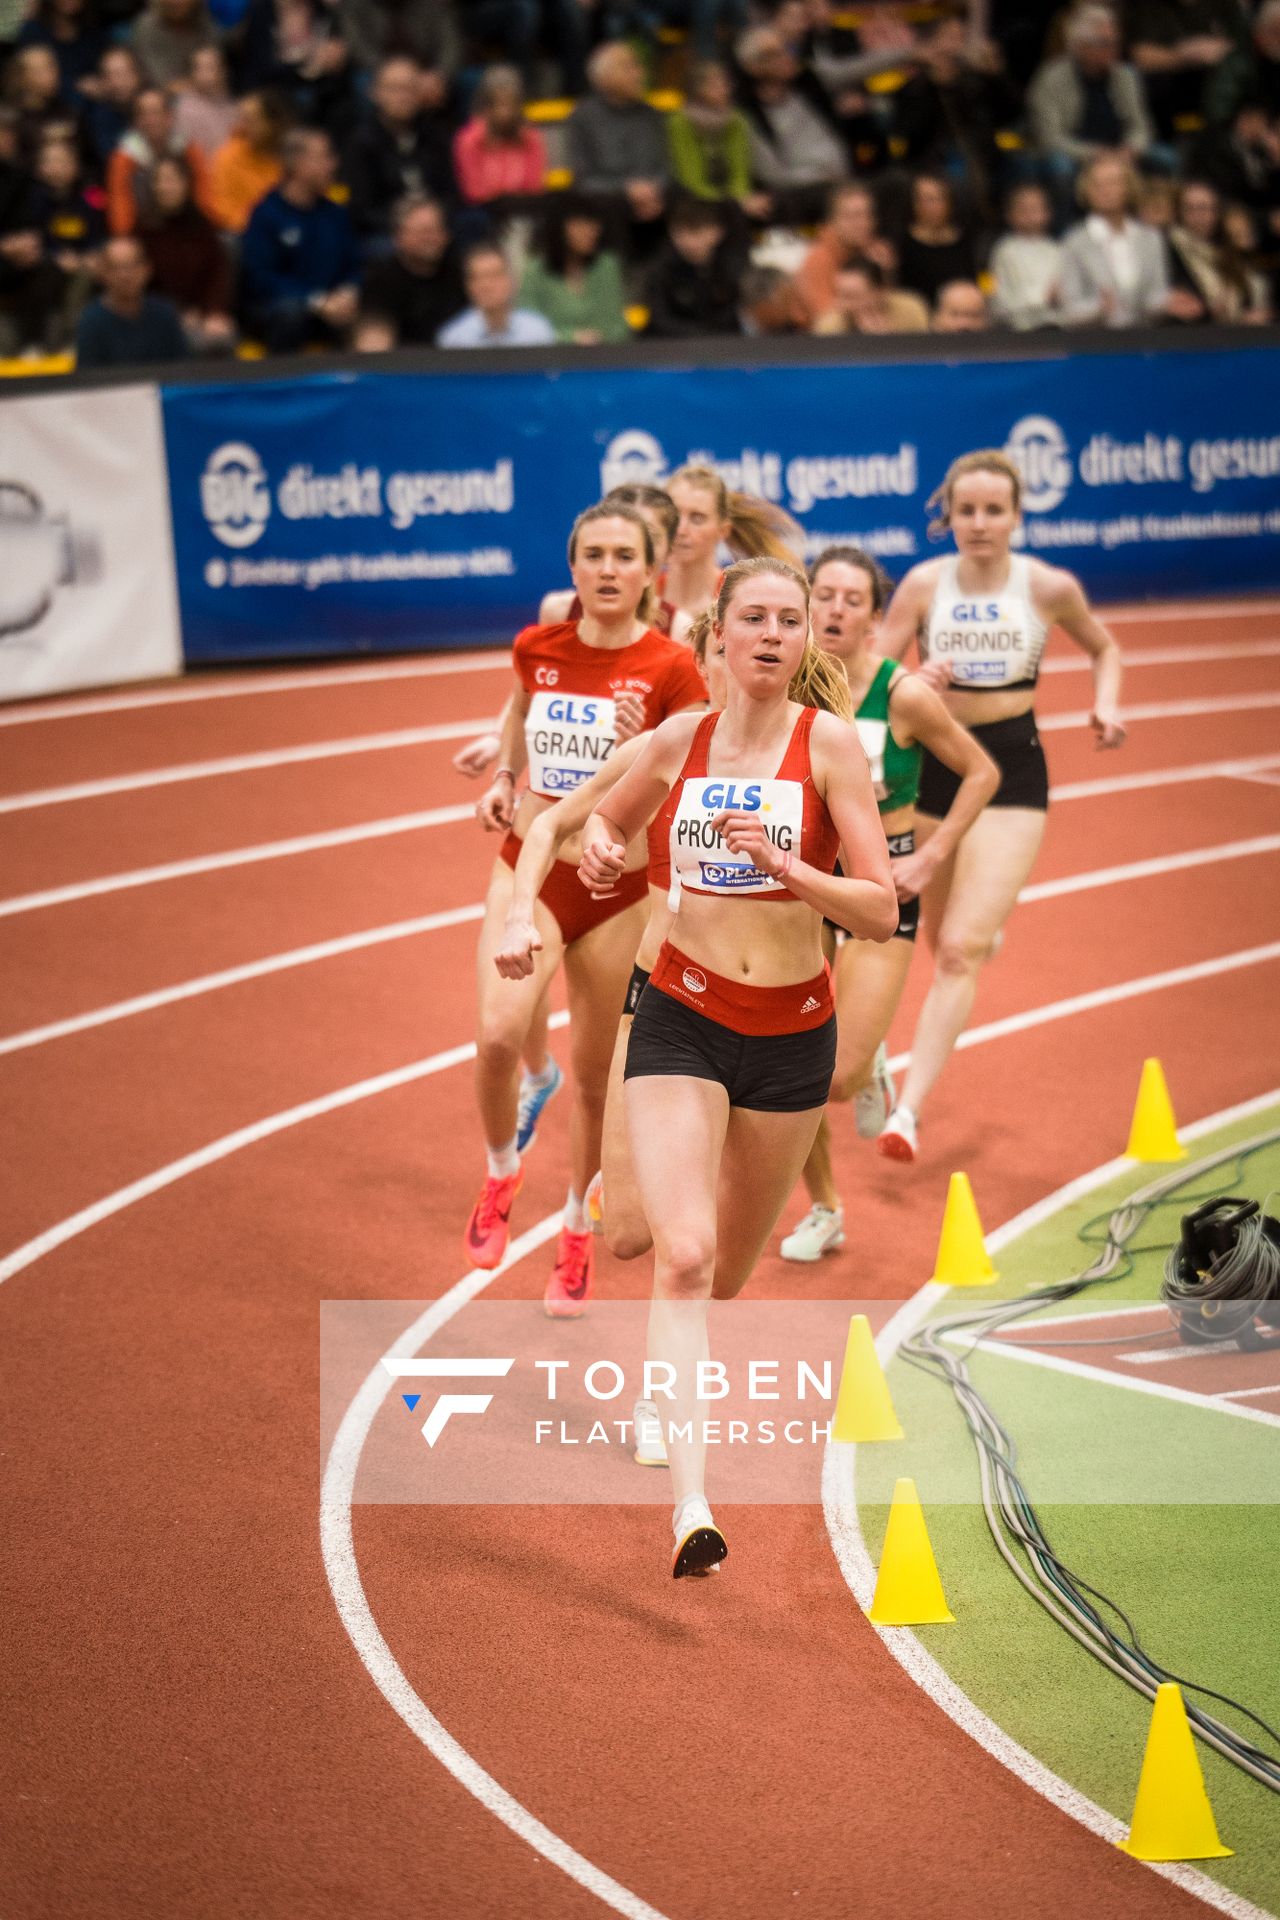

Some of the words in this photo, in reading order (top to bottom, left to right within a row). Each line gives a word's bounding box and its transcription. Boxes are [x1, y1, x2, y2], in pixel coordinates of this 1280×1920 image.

[786, 443, 917, 513] gesund
[1079, 432, 1183, 487] direkt
[386, 456, 514, 530] gesund
[935, 631, 1024, 653] GRONDE
[534, 667, 559, 686] CG
[534, 730, 616, 762] GRANZ
